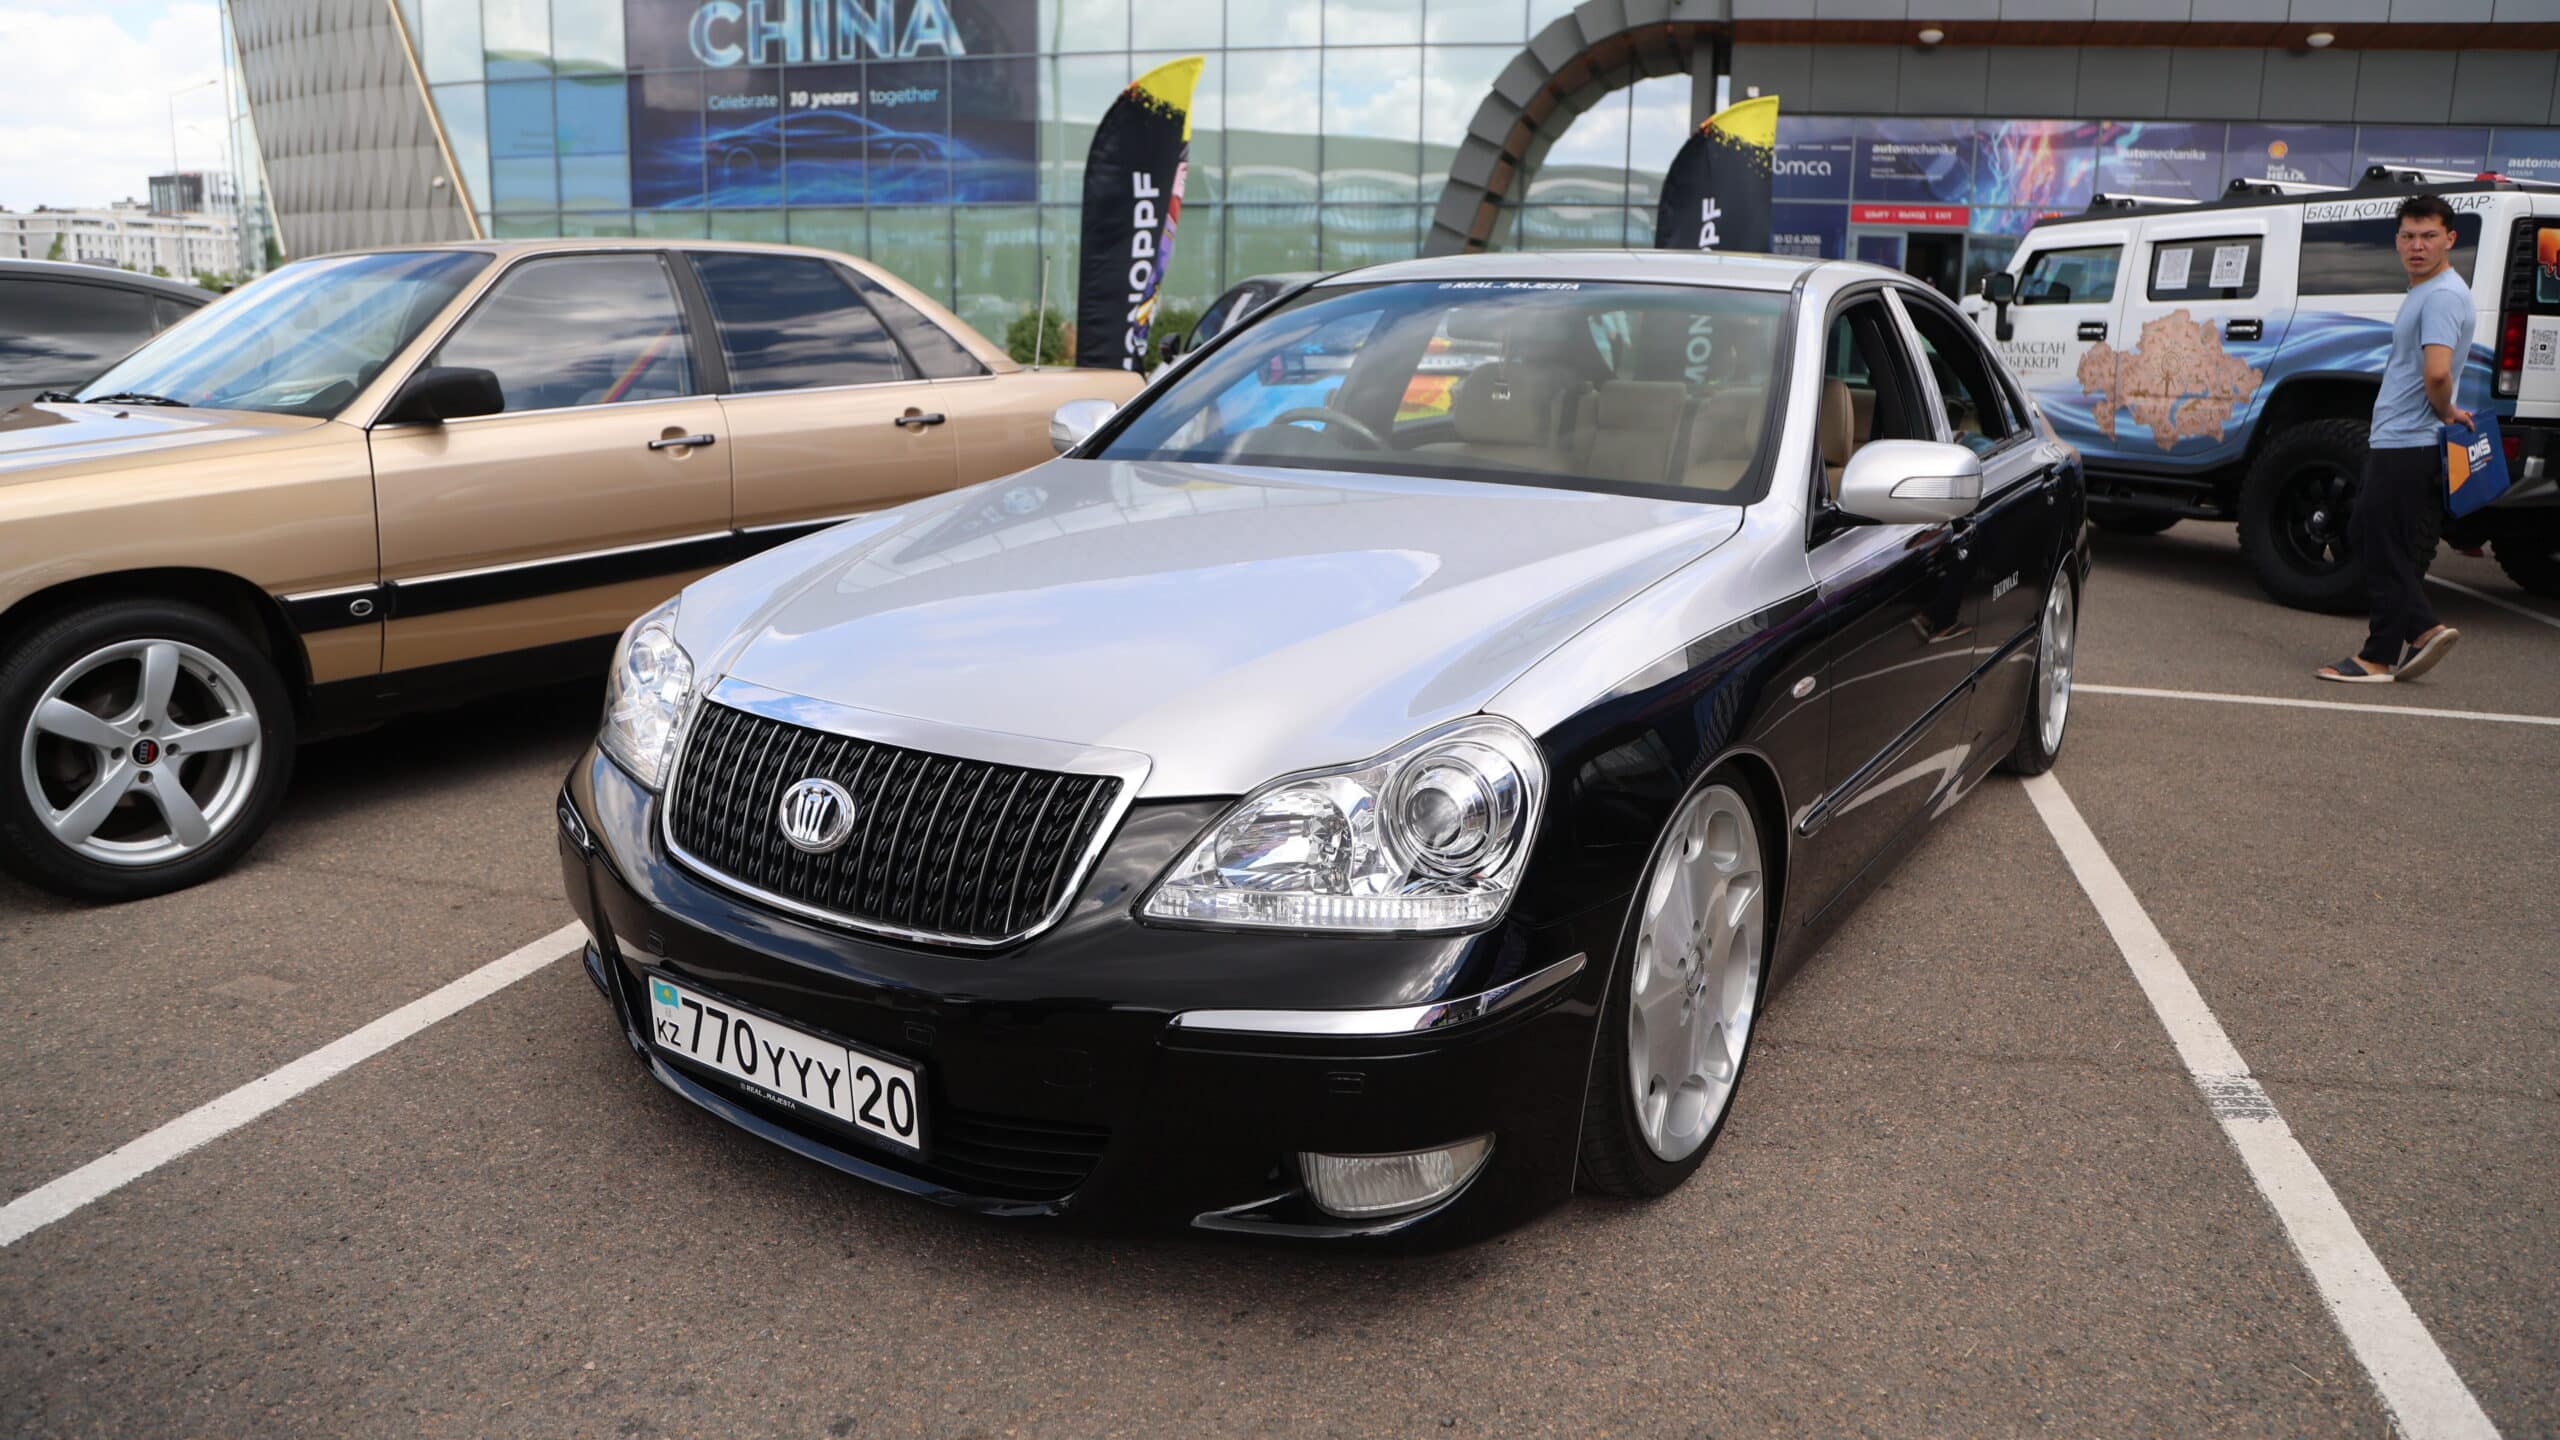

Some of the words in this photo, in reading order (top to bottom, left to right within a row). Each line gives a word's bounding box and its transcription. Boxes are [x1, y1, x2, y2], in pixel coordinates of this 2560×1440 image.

[689, 0, 966, 68] CHINA
[708, 94, 779, 111] Celebrate
[789, 91, 808, 108] 10
[810, 91, 860, 110] years
[869, 86, 939, 106] together
[2117, 147, 2207, 161] automechanika
[1698, 197, 1722, 253] PF
[656, 1017, 681, 1047] KZ
[856, 1066, 914, 1138] 20
